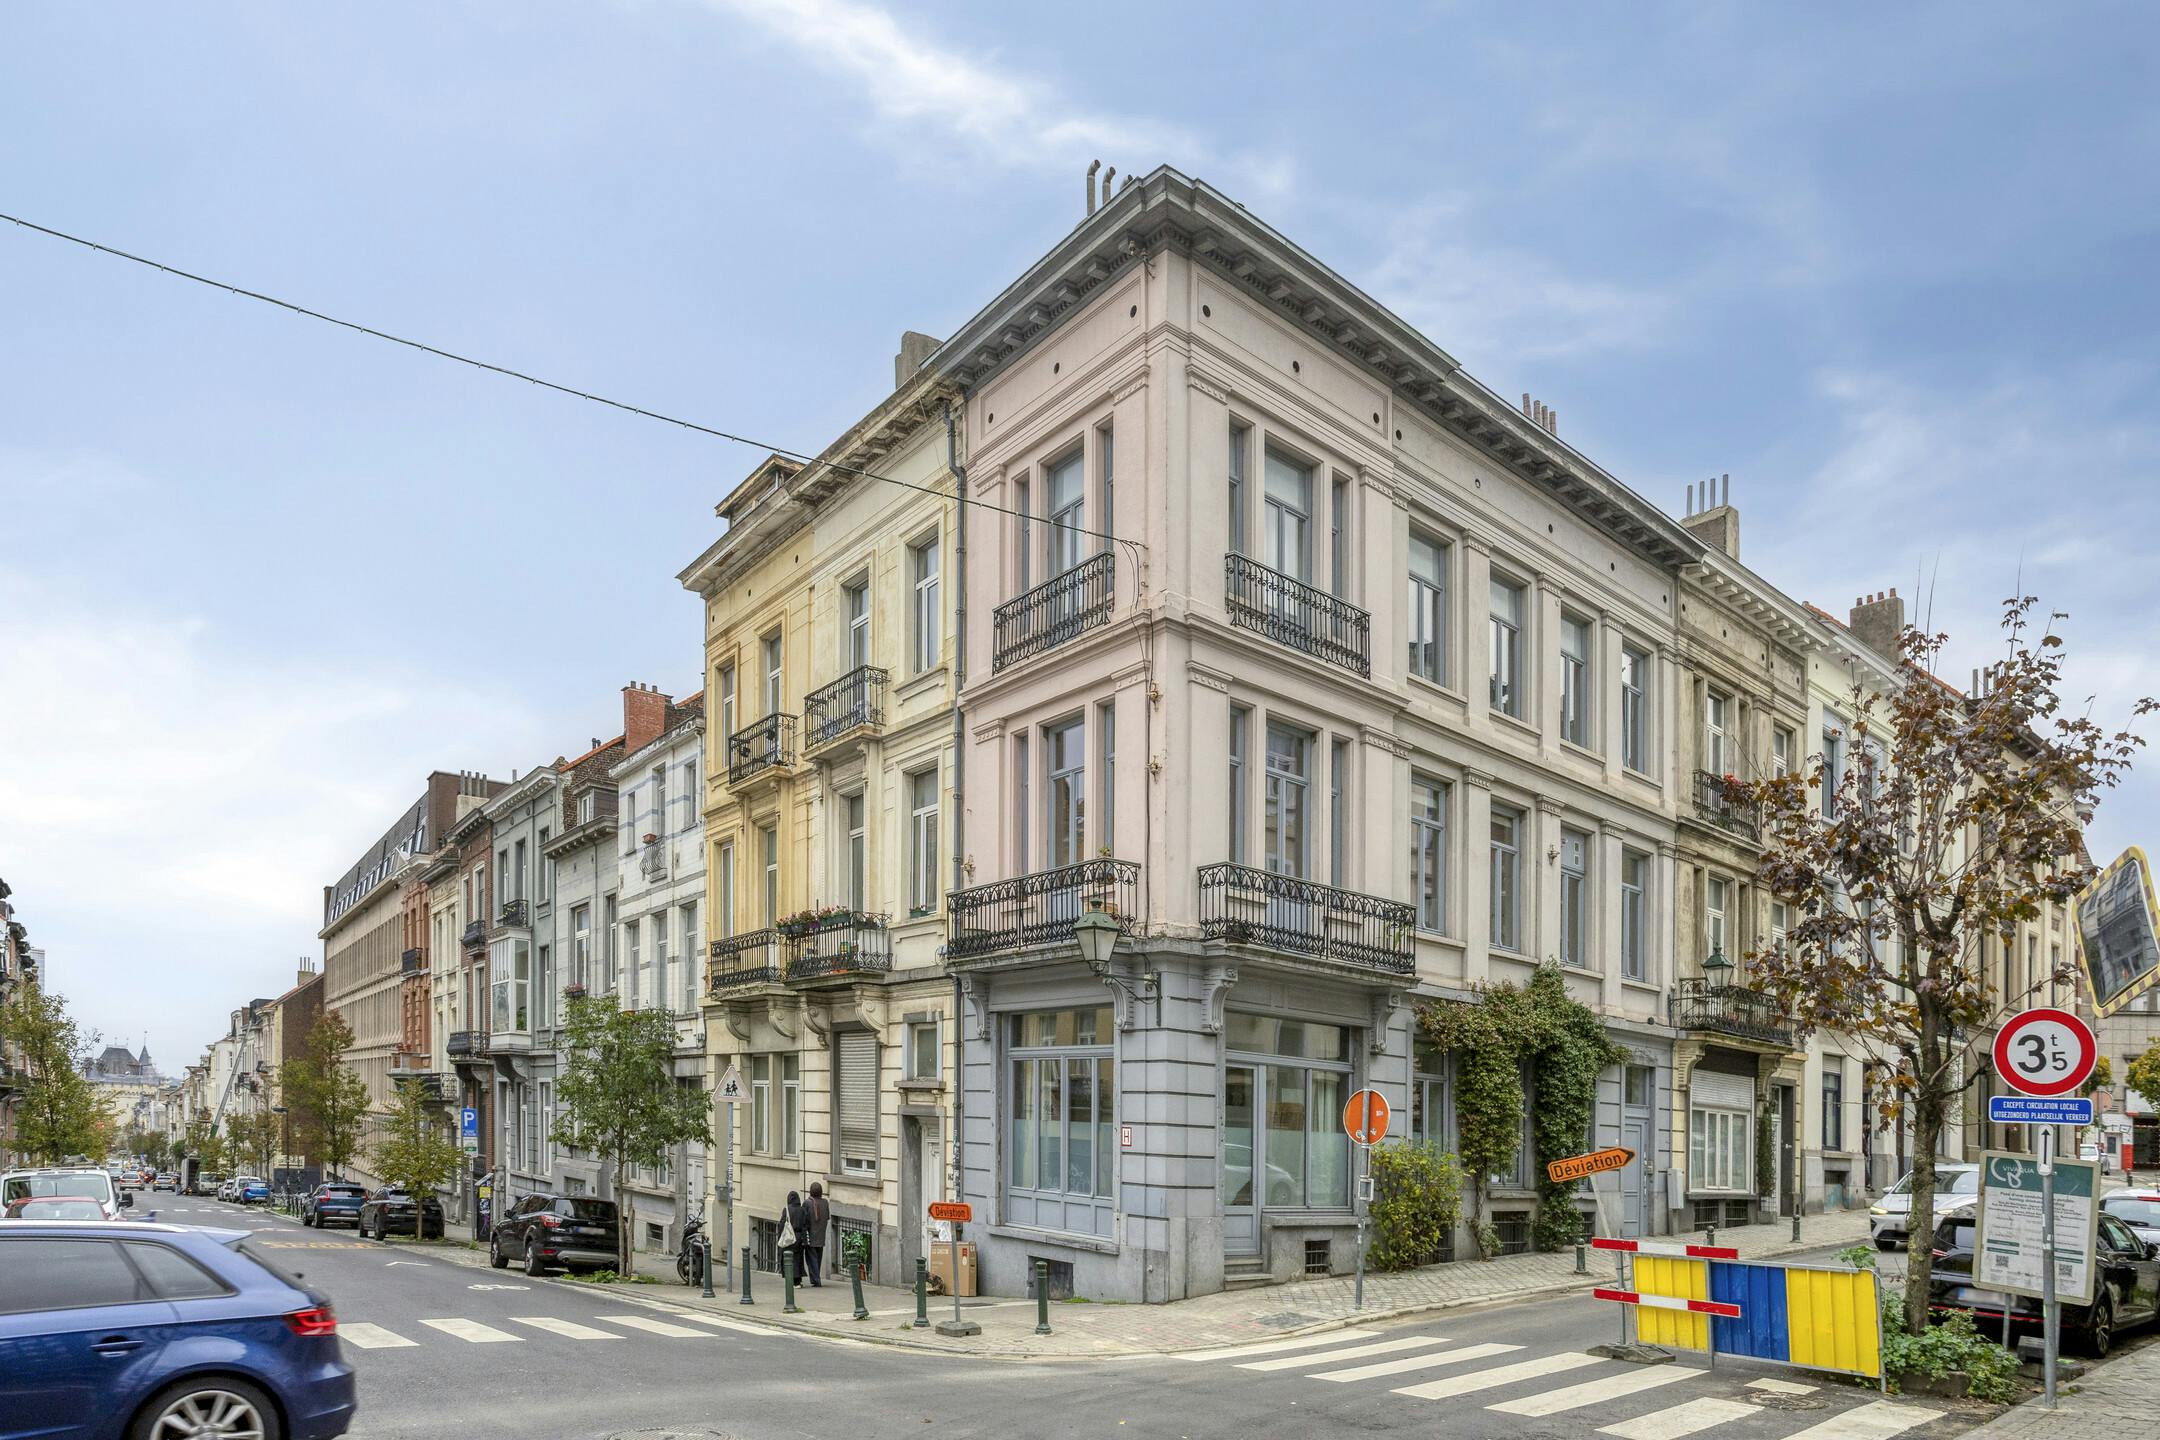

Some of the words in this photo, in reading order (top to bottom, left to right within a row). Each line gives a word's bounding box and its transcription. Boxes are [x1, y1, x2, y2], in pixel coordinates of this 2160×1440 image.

[2017, 1034, 2047, 1073] 3
[2052, 1051, 2068, 1071] 5
[2027, 1102, 2058, 1110] CIRCULATION
[463, 1111, 475, 1127] P
[1993, 1111, 2029, 1119] UITGEZONDERD
[2031, 1112, 2063, 1120] PLAATSELIJK
[2066, 1113, 2089, 1121] VERKEER
[1553, 1154, 1622, 1178] Déviation
[2002, 1165, 2034, 1174] VIVAQUA
[935, 1206, 966, 1218] Déviation
